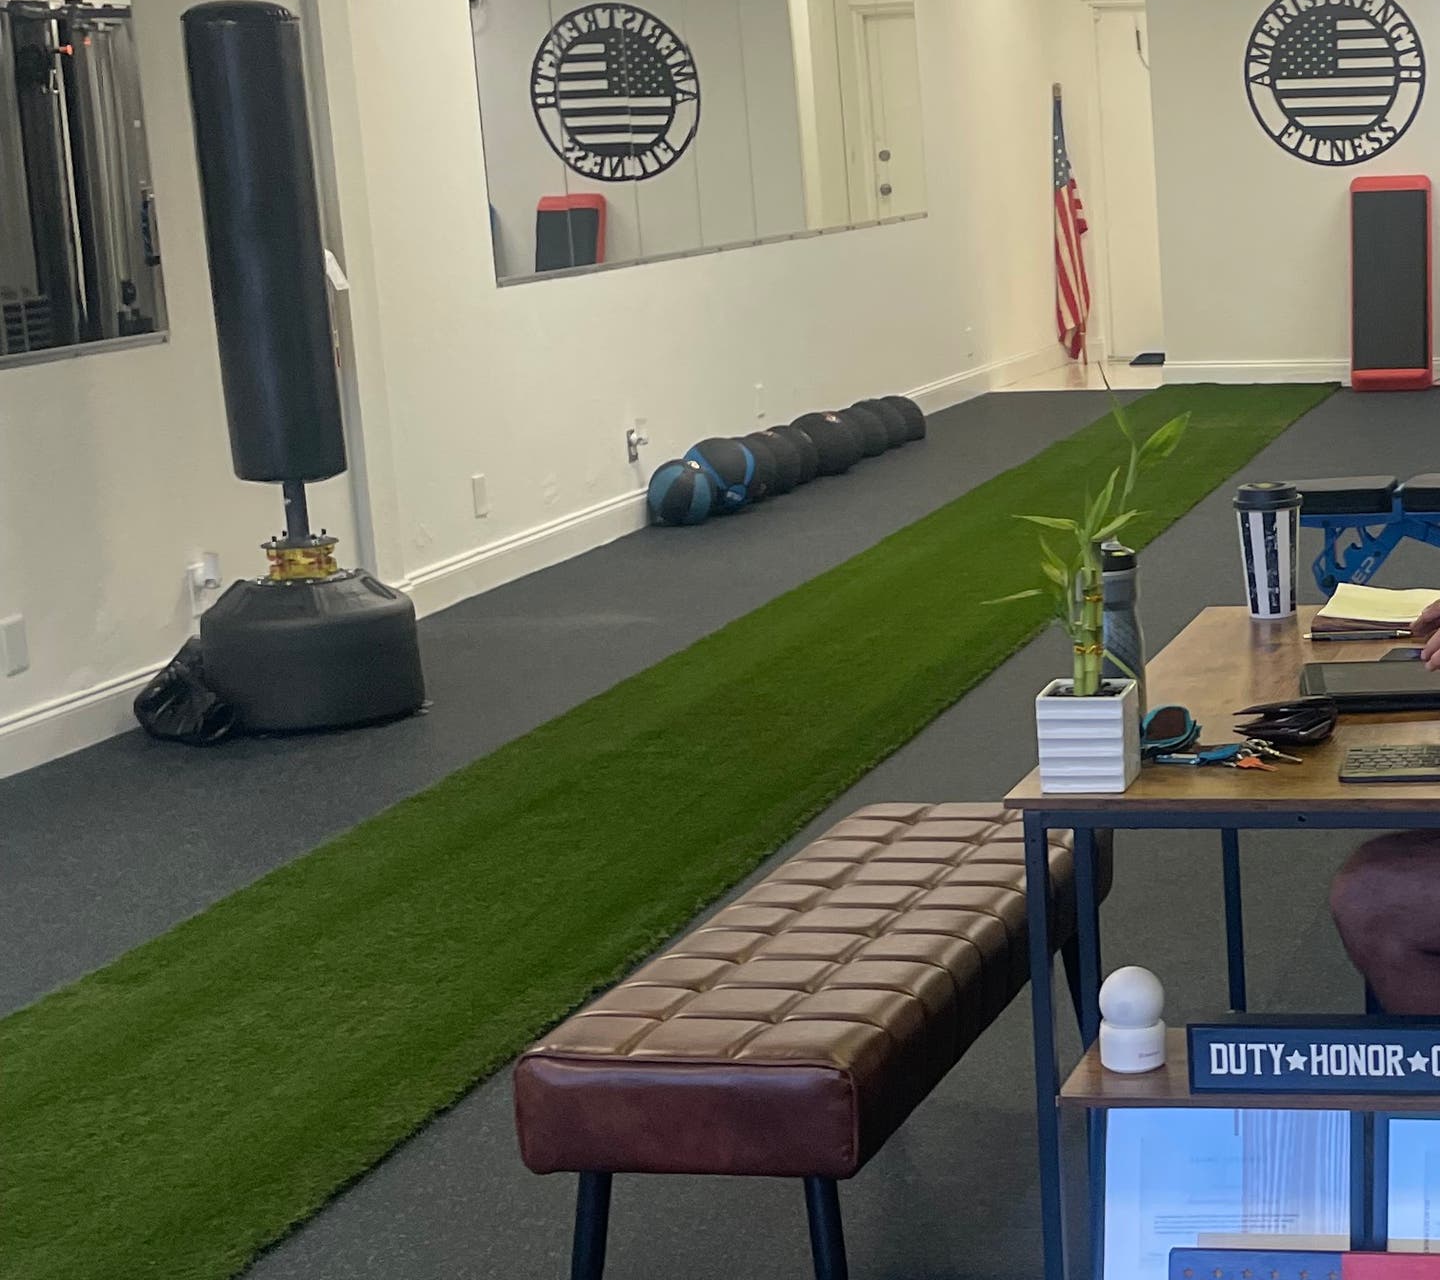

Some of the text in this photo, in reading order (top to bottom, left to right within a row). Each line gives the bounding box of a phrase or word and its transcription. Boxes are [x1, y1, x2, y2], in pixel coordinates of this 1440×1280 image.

[1276, 118, 1398, 161] FITNESS
[1351, 555, 1375, 584] EP
[1209, 1042, 1286, 1076] DUTY
[1309, 1043, 1406, 1078] HONOR
